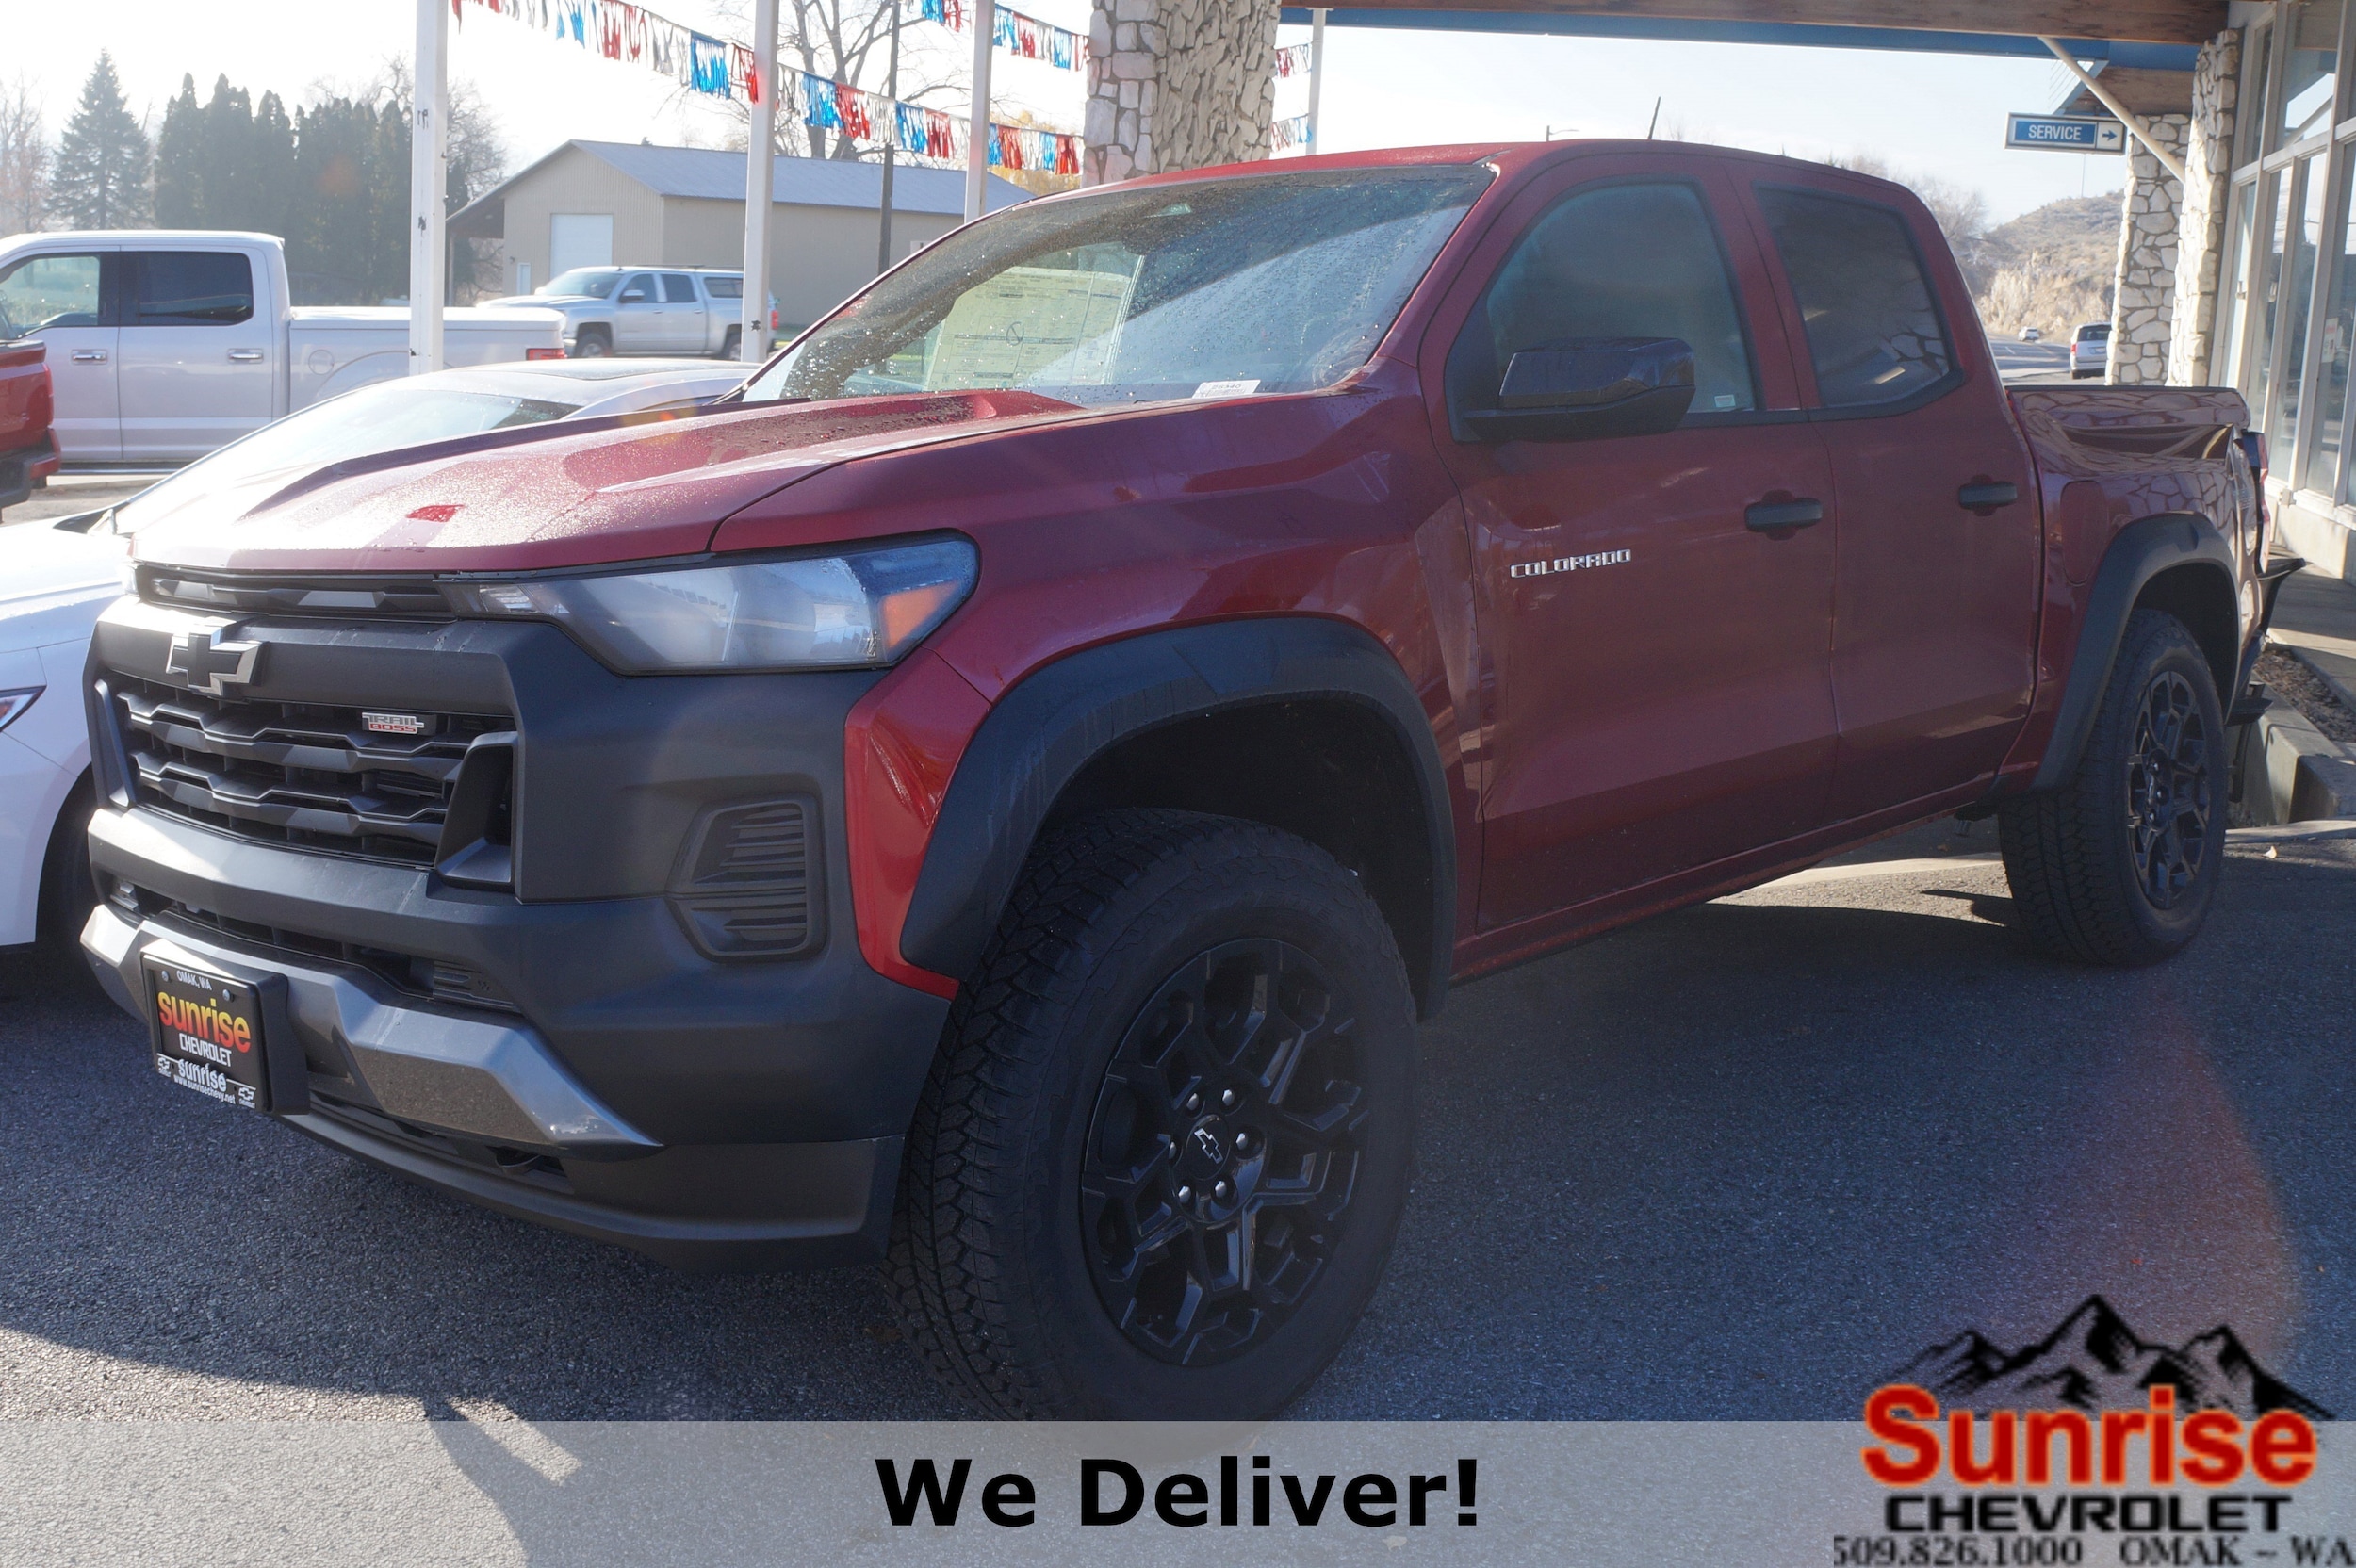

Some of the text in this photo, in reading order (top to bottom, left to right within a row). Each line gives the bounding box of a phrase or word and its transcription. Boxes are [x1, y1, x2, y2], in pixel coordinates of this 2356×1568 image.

[2028, 124, 2082, 140] SERVICE
[1511, 549, 1631, 578] COLORADO
[362, 712, 424, 727] TRAIL
[369, 723, 417, 733] BOSS
[200, 977, 212, 990] WA
[158, 991, 251, 1053] sunrise
[179, 1033, 232, 1067] CHEVROLET
[178, 1059, 227, 1092] sunrise
